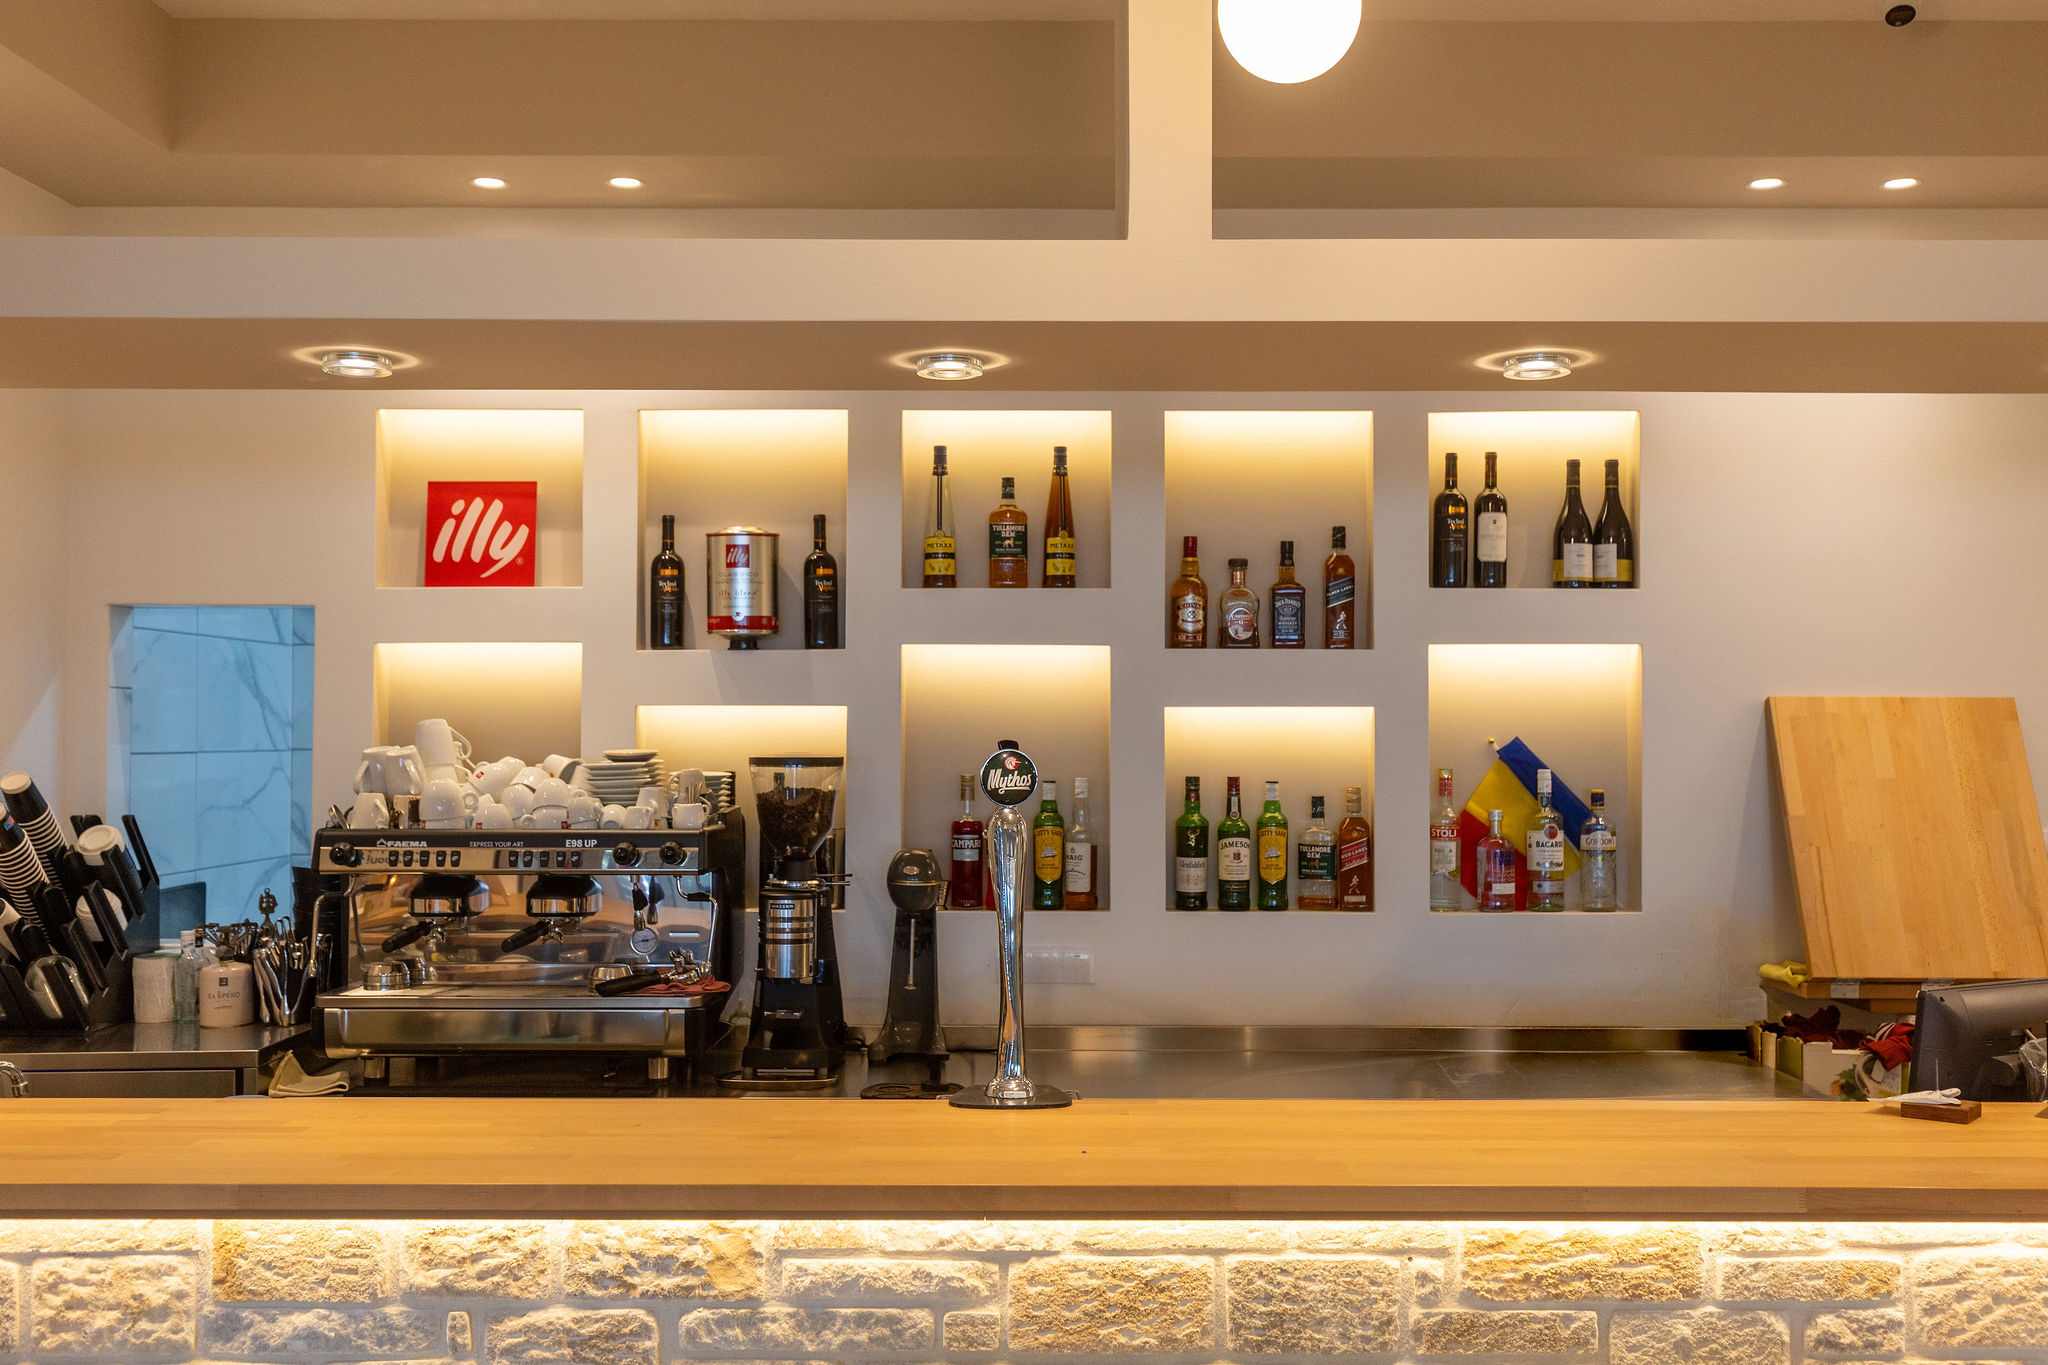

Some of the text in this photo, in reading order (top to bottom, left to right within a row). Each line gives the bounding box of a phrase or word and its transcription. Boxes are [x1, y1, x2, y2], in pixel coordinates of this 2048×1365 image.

[433, 497, 529, 578] illy
[727, 547, 748, 566] illy
[987, 769, 1032, 794] Mythos
[1431, 829, 1457, 837] STOLI
[565, 840, 598, 848] E98 UP
